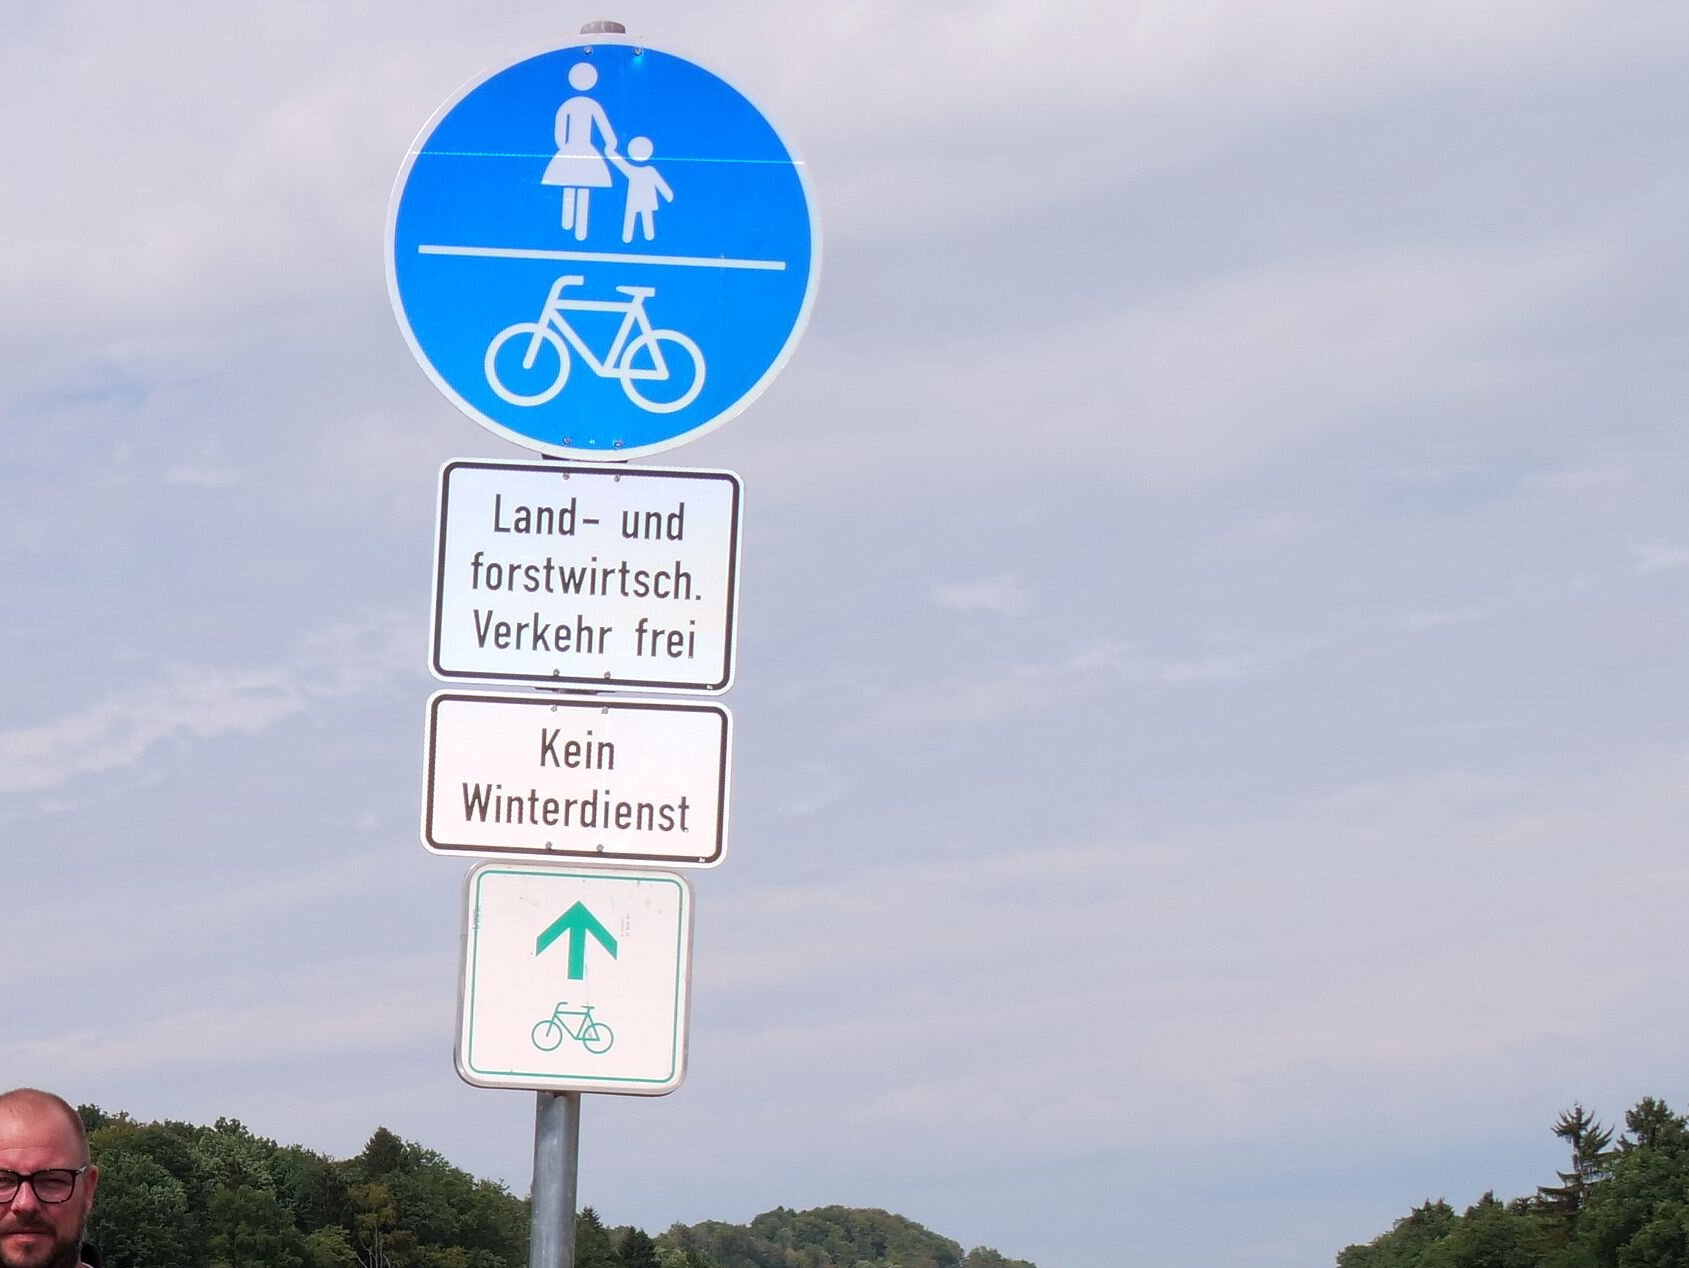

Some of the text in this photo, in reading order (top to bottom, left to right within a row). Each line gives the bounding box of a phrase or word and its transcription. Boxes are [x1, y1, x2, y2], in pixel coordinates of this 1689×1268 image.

[493, 493, 685, 541] Land- und
[470, 551, 702, 601] forstwirtsch.
[472, 609, 696, 659] Verkehr frei
[539, 727, 615, 770] Kein
[462, 781, 690, 832] Winterdienst
